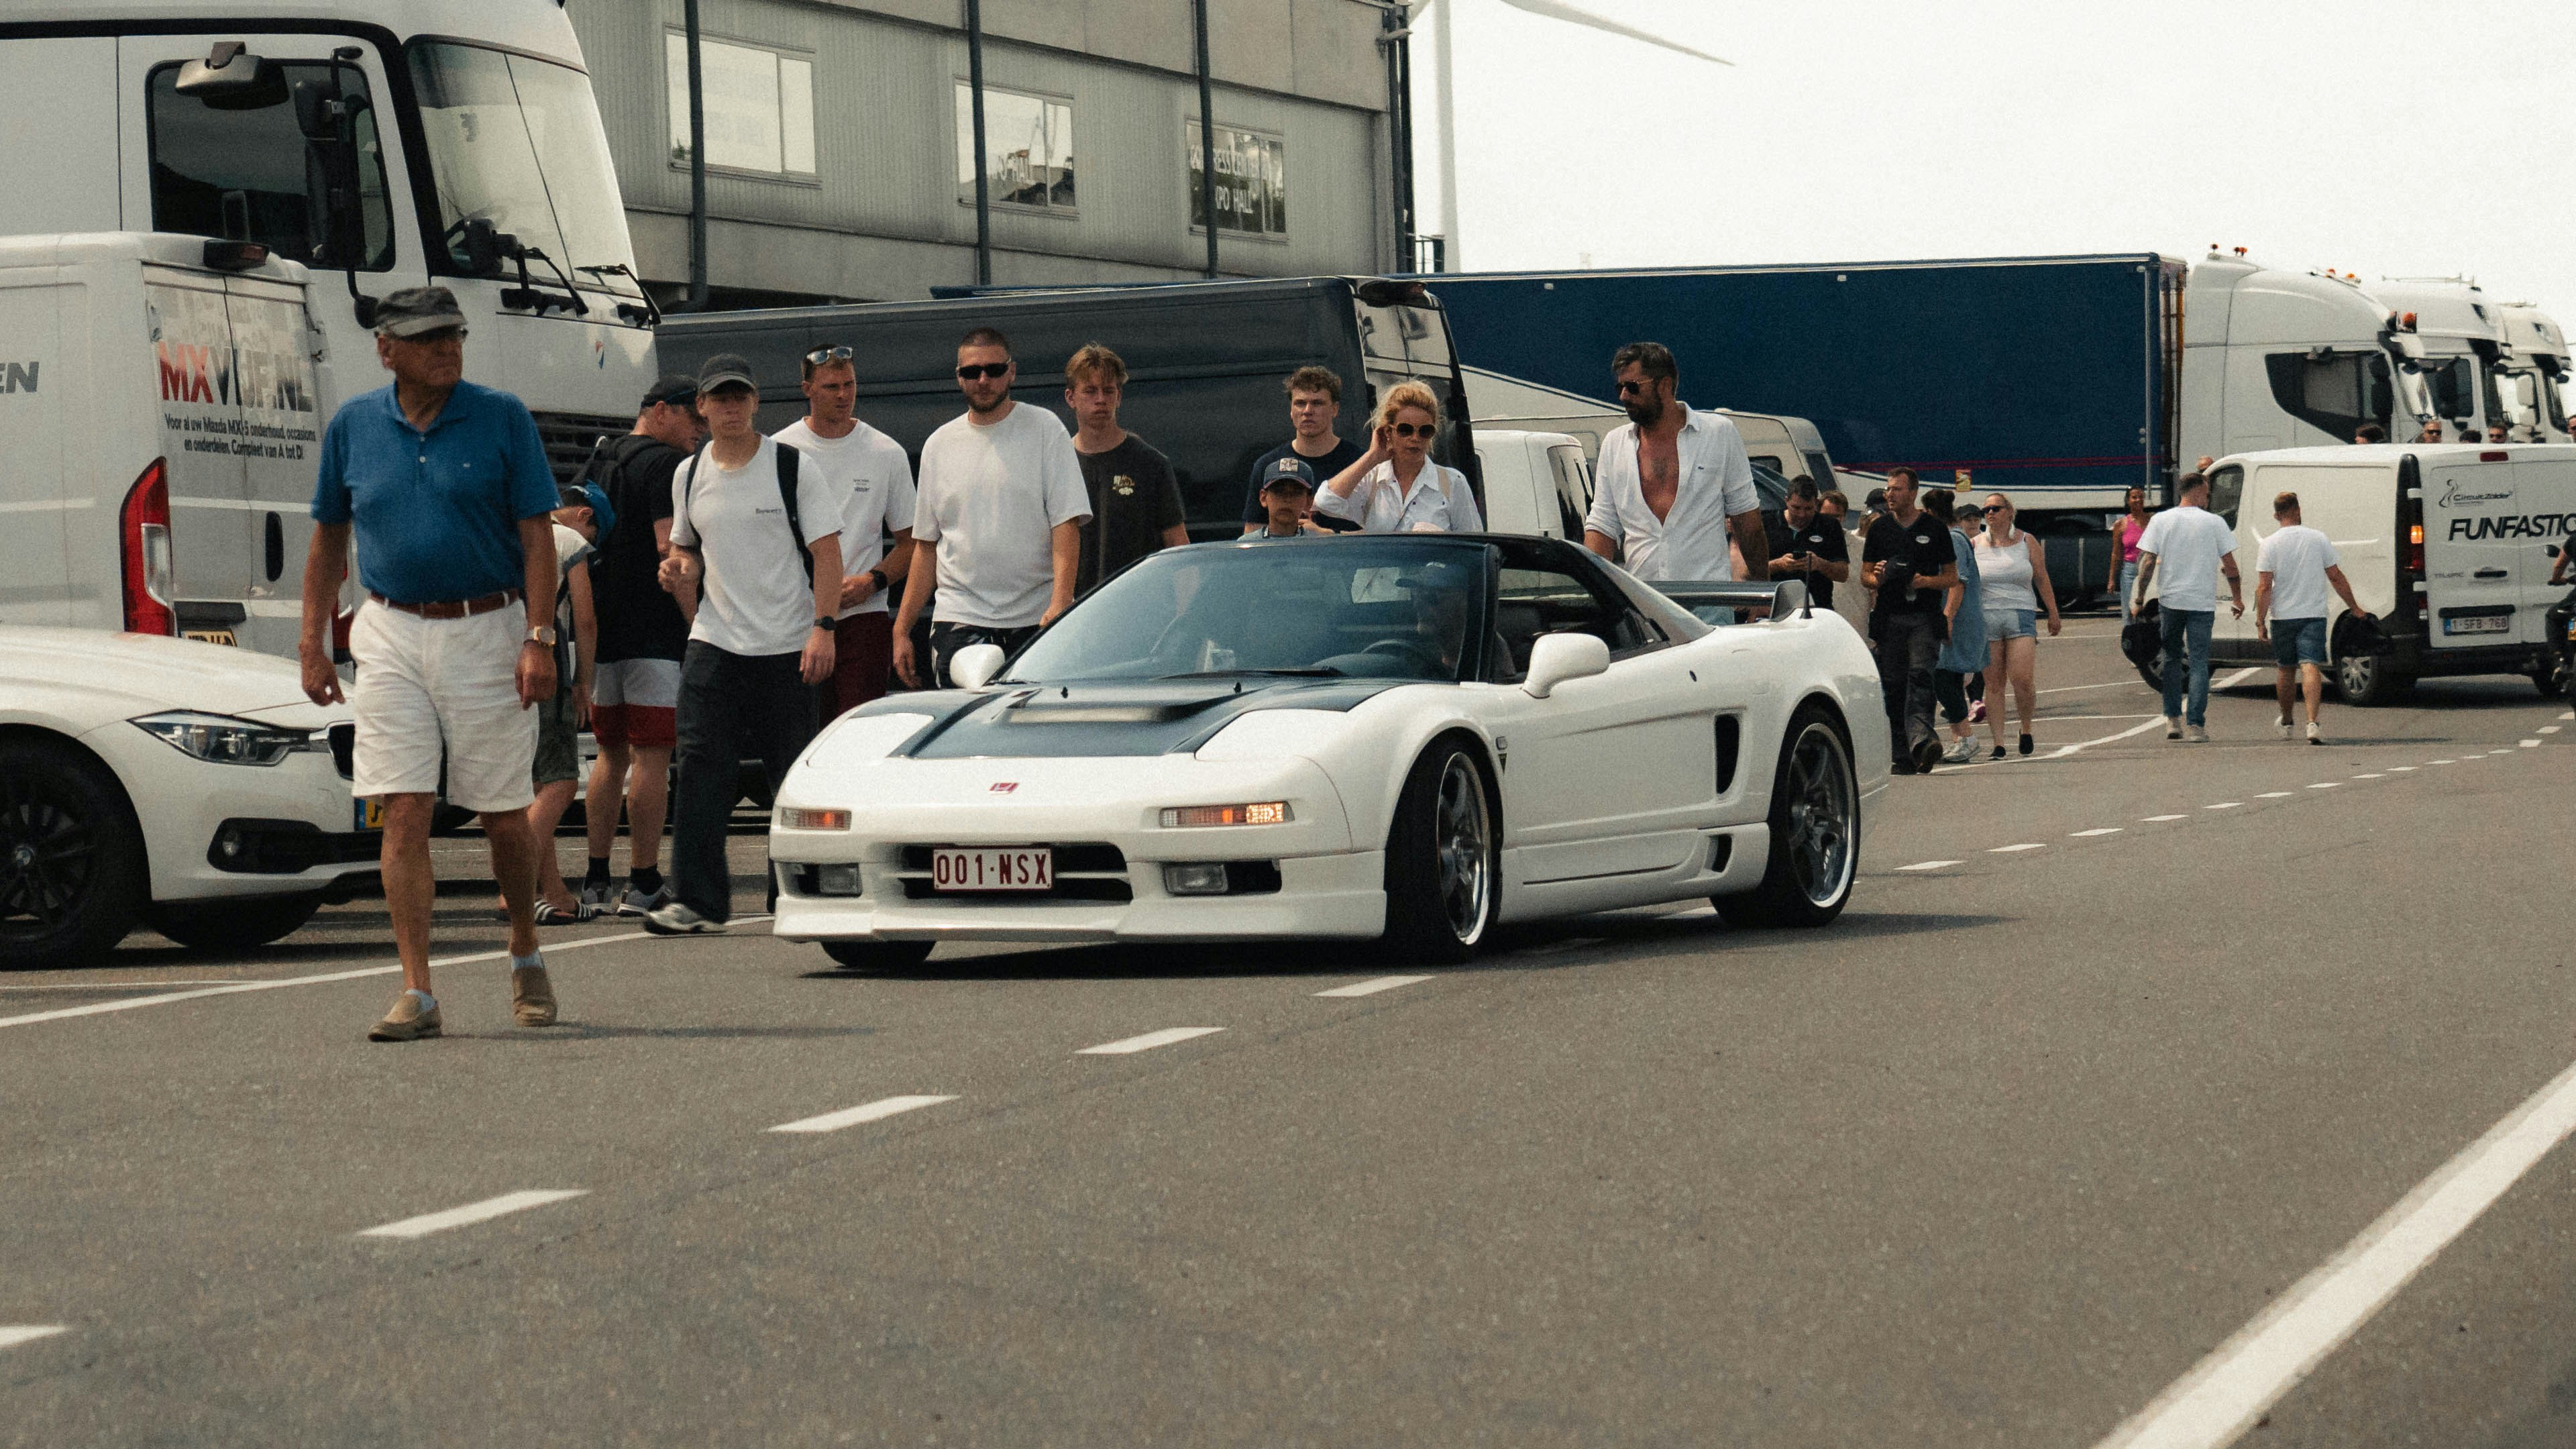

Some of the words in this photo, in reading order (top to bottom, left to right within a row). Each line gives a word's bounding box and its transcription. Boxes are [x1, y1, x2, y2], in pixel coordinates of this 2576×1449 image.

[164, 413, 182, 430] Voor
[183, 415, 190, 431] al
[191, 419, 203, 431] uw
[203, 417, 227, 434] Mazda
[286, 425, 316, 441] occasions
[184, 438, 193, 451] en
[231, 439, 264, 458] Compleet
[264, 445, 276, 459] van
[278, 443, 284, 459] A
[285, 444, 296, 460] tot
